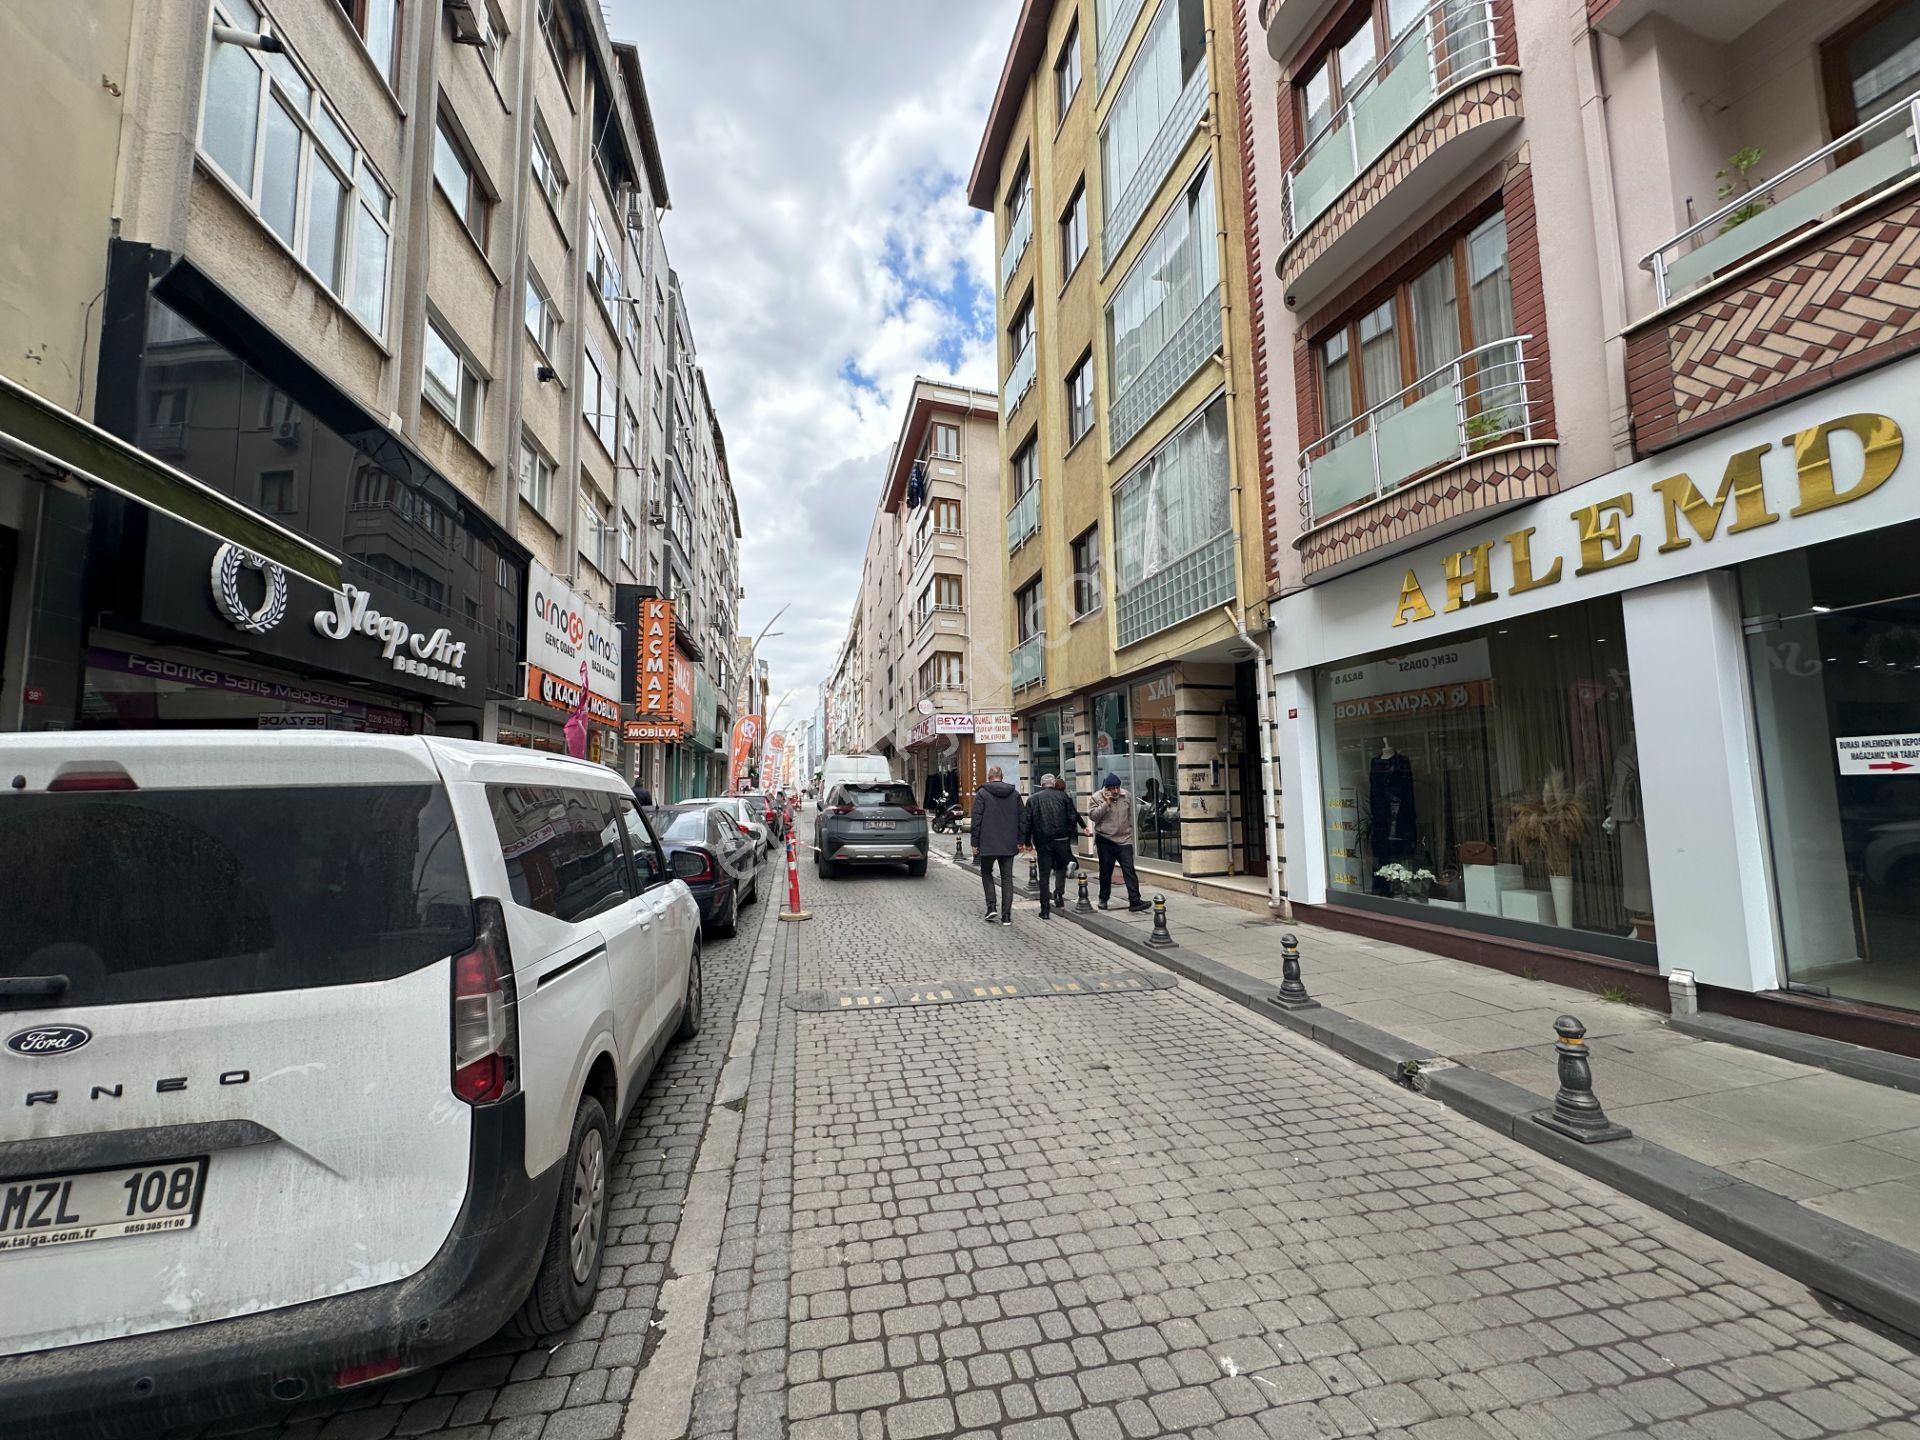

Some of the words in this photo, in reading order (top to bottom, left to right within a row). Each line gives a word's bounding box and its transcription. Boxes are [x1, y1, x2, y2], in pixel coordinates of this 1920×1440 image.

[1391, 413, 1904, 628] AHLEMD
[314, 584, 409, 660] Sleep
[410, 628, 467, 669] Art
[545, 632, 559, 653] GENÇ
[560, 641, 576, 659] ODASI
[588, 629, 611, 661] arno
[645, 603, 664, 710] KAÇMAZ
[127, 655, 218, 684] Fabrika
[393, 655, 466, 688] BEDDING
[628, 726, 678, 738] MOBİLYA
[937, 717, 973, 725] BEYZA
[21, 1031, 71, 1050] Ford
[26, 1070, 249, 1106] RNEO
[0, 1181, 80, 1231] MZL
[124, 1167, 195, 1216] 108
[163, 1220, 172, 1229] 11
[174, 1219, 185, 1227] 00
